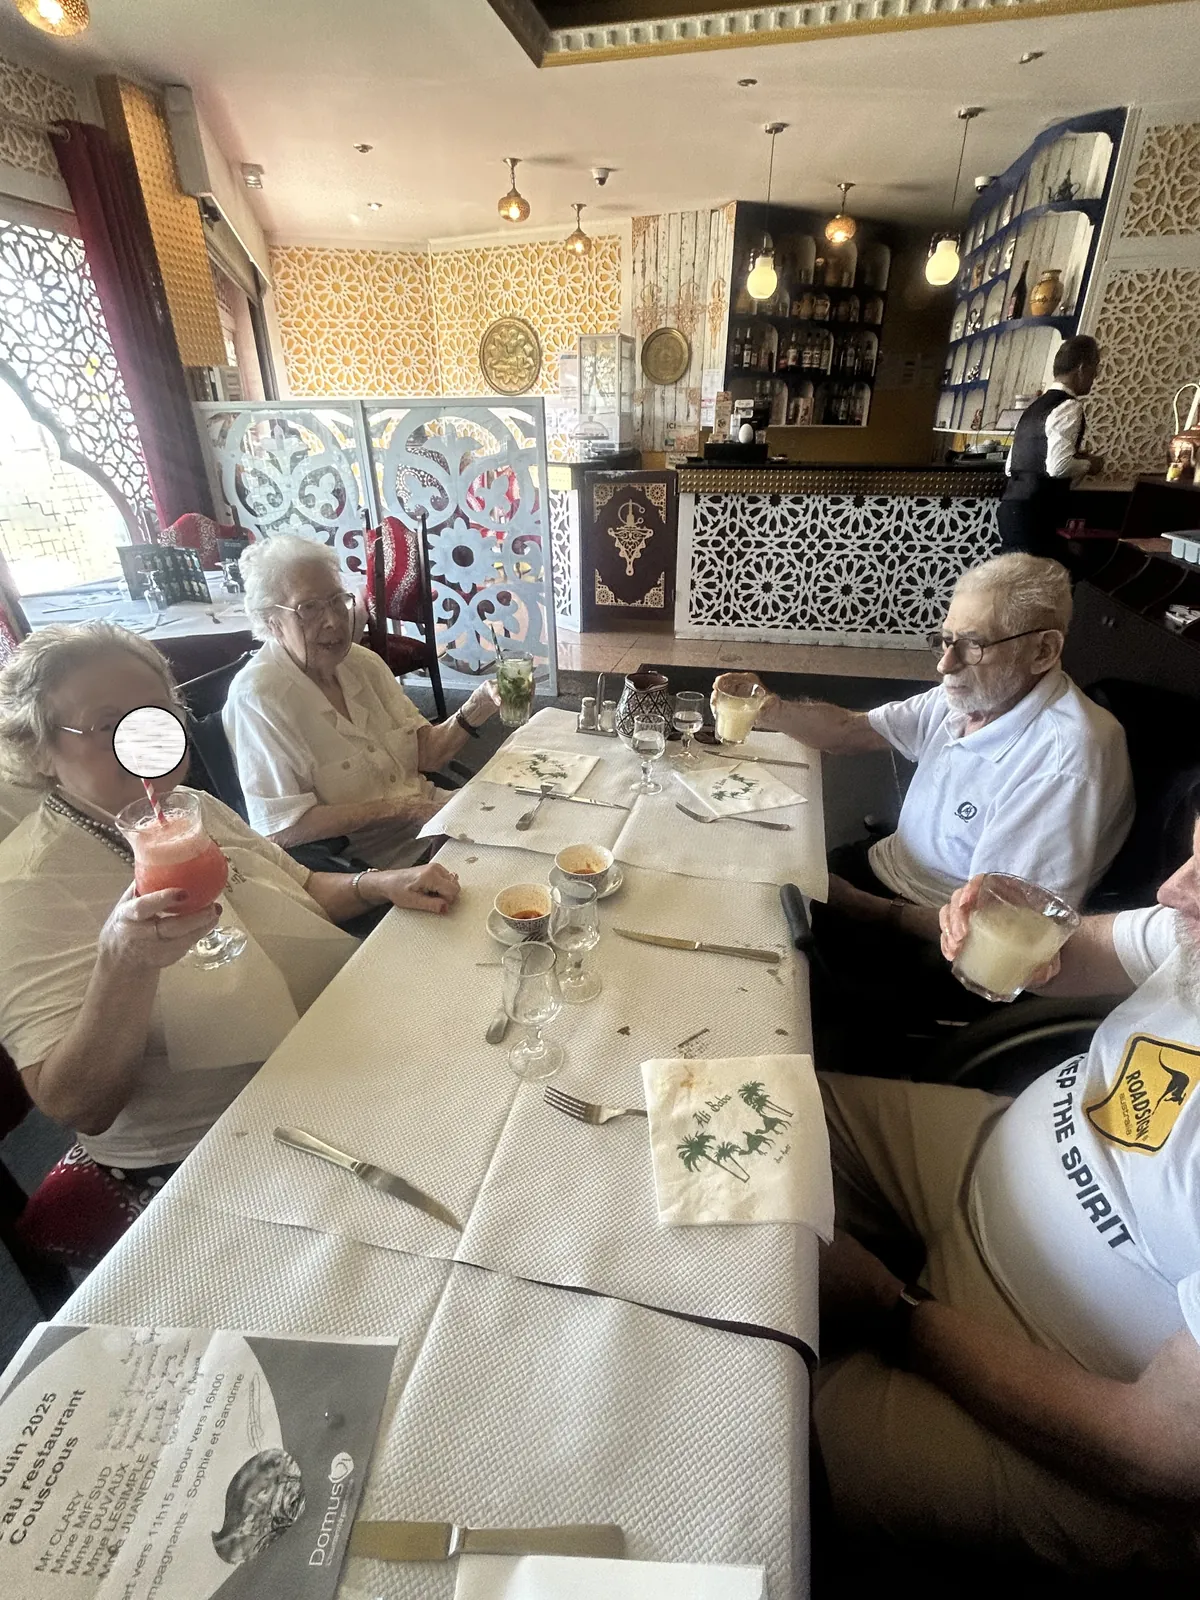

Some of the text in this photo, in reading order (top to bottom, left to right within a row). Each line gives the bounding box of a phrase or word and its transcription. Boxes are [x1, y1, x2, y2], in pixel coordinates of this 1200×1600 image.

[692, 1094, 732, 1128] Ali Baba
[1053, 1092, 1076, 1144] THE
[1119, 1093, 1132, 1135] australia
[1126, 1070, 1152, 1141] ROADSIGN
[1061, 1146, 1136, 1250] SPIRIT
[22, 1392, 57, 1437] 2025
[210, 1432, 221, 1445] et
[215, 1373, 244, 1429] Sandrine
[3, 1389, 86, 1525] au restaurant
[10, 1436, 79, 1545] Couscous
[132, 1543, 153, 1578] vers
[149, 1493, 175, 1537] 11h15
[171, 1448, 194, 1488] retour
[190, 1415, 208, 1443] vers
[203, 1373, 225, 1410] 16h00
[187, 1449, 214, 1498] Sophie
[35, 1490, 84, 1572] Mr CLARY
[50, 1466, 112, 1574] Mme MIFSUD
[66, 1534, 94, 1575] Mme
[89, 1462, 129, 1530] DUVAUX
[82, 1536, 110, 1577] Mme
[104, 1453, 149, 1532] LESIMPLE
[121, 1459, 160, 1534] JUANEDA
